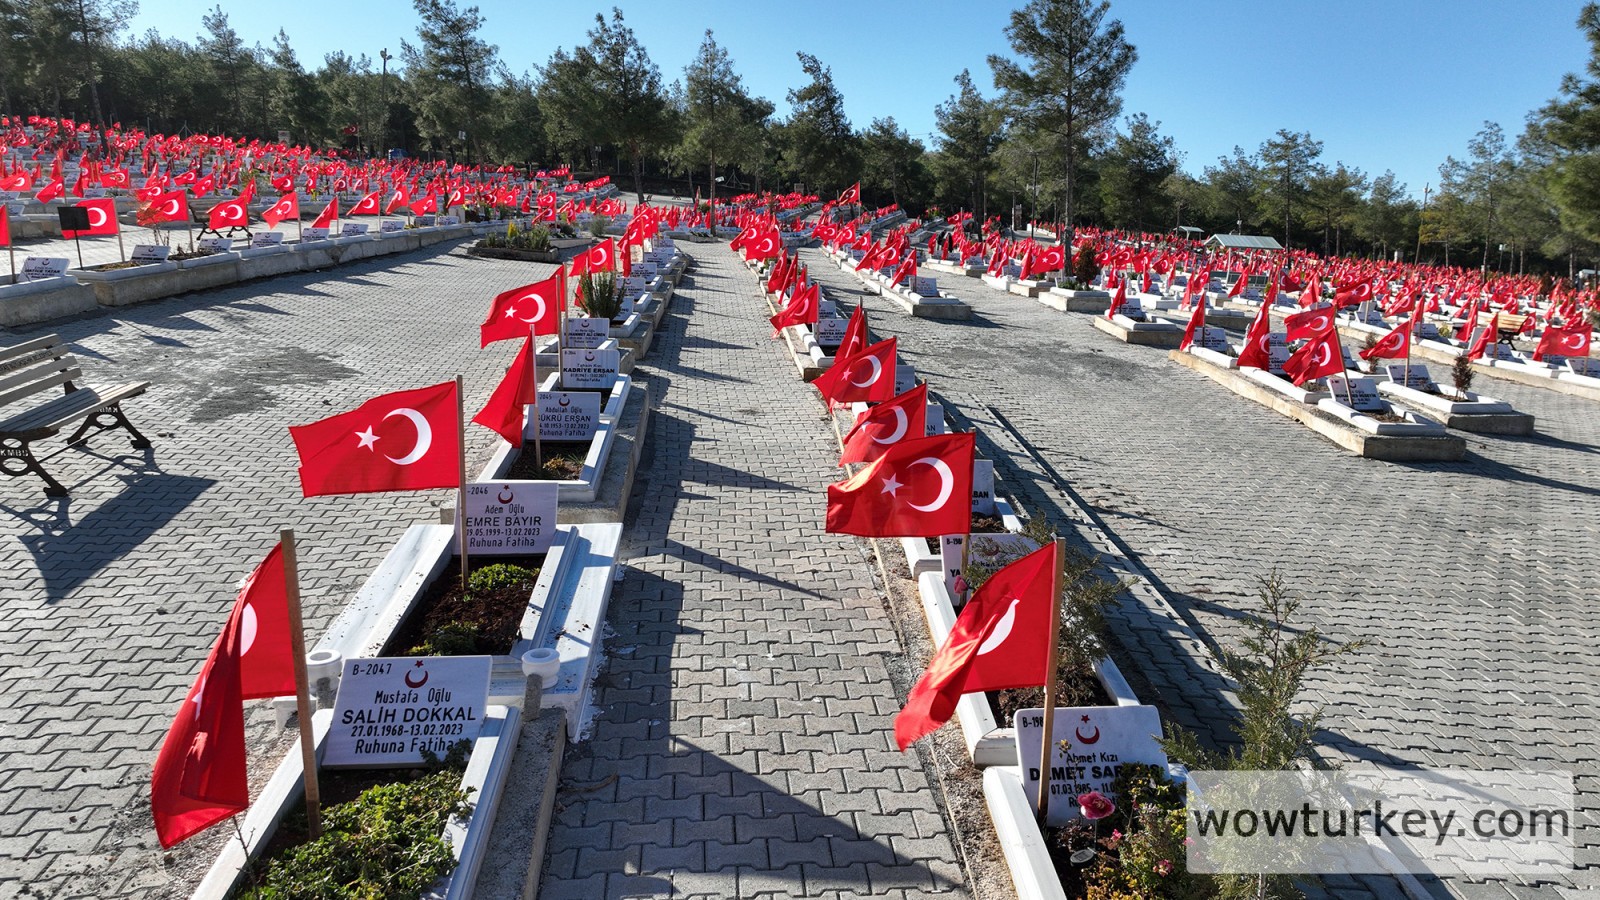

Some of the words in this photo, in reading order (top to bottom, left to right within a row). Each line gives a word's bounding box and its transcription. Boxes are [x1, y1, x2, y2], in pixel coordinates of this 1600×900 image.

[467, 486, 488, 495] -2046
[485, 505, 503, 514] Adem
[509, 504, 524, 516] Oğlu
[466, 517, 500, 527] EMRE
[505, 516, 541, 526] BAYIR
[470, 538, 502, 548] Ruhuna
[506, 537, 535, 547] Fatiha
[352, 664, 392, 676] B-2047
[374, 690, 418, 704] Mustafa
[428, 688, 451, 706] Oğlu
[342, 706, 395, 724] SALİH
[403, 706, 476, 722] DOKKAL
[351, 724, 463, 737] 27.01.1968-13.02.2023
[355, 738, 404, 754] Ruhuna
[410, 737, 454, 752] Fatiha
[1066, 752, 1097, 764] Ahmet
[1100, 752, 1118, 762] Kızı
[1030, 766, 1086, 781] DMET
